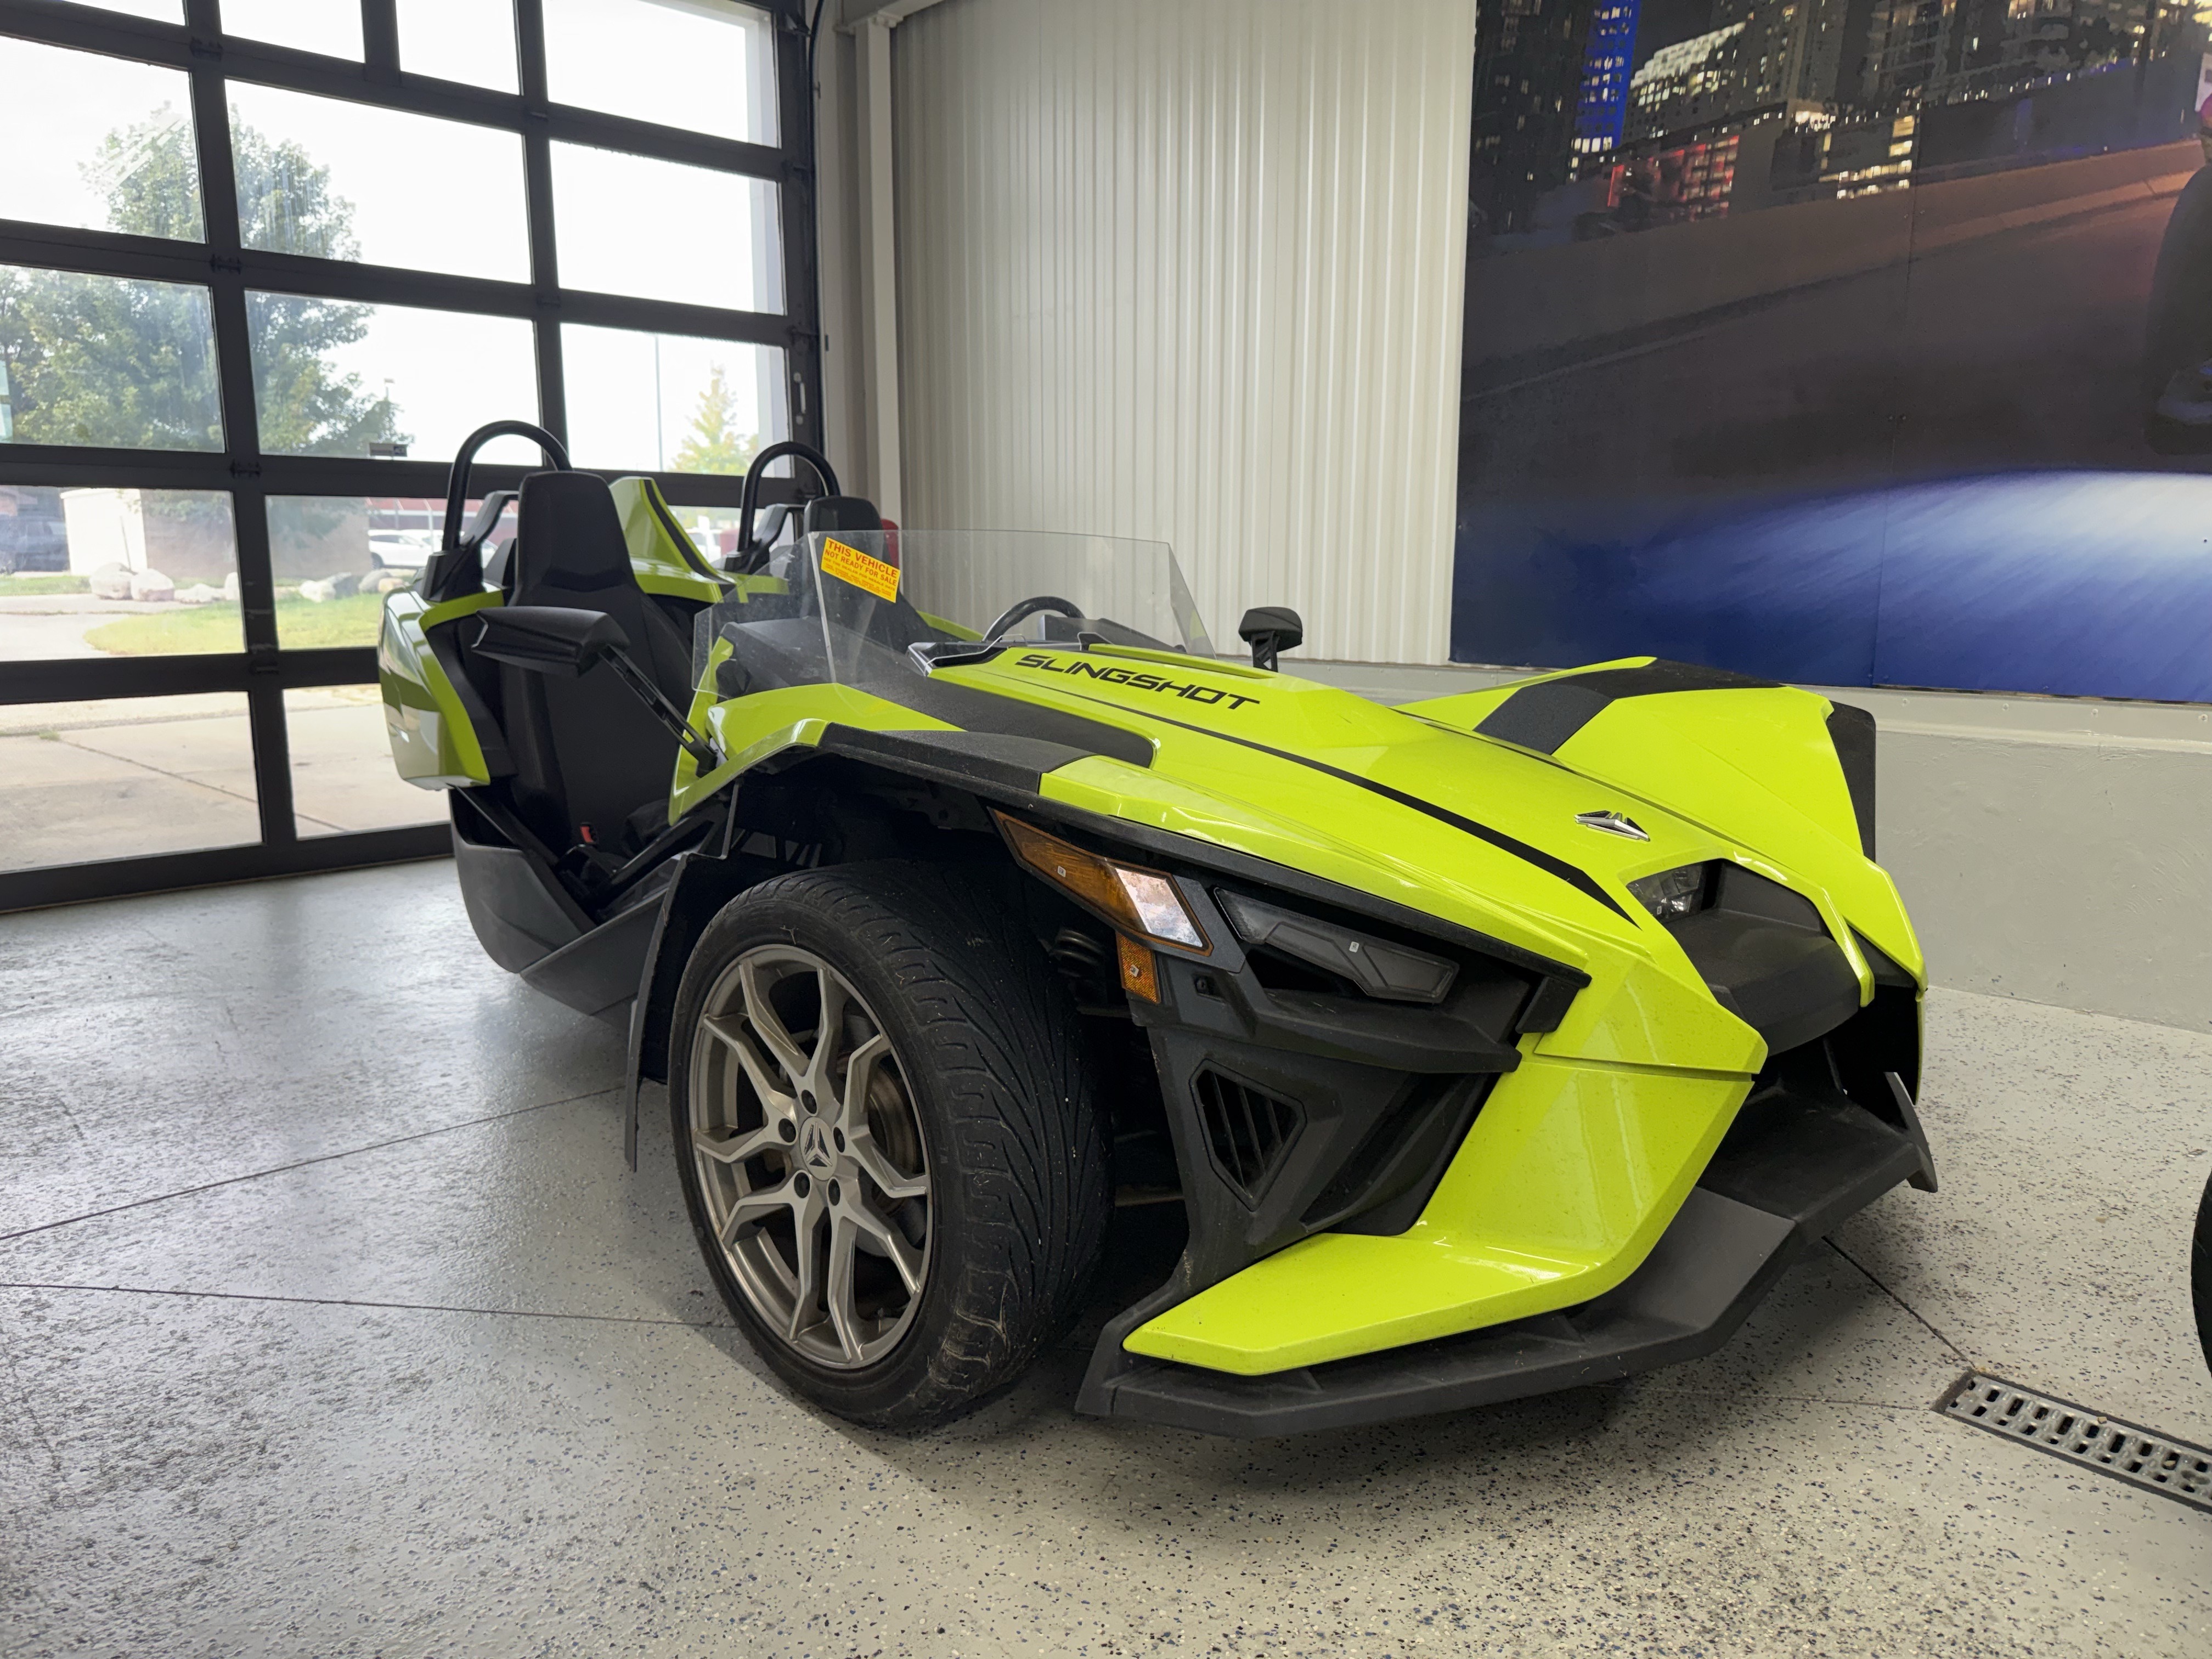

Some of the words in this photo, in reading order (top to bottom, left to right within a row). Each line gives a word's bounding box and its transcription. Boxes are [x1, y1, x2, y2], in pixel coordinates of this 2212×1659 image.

[825, 548, 839, 560] NOT
[840, 555, 863, 571] READY
[865, 567, 878, 578] FOR
[880, 573, 896, 586] SALE
[827, 539, 851, 557] THIS
[855, 552, 898, 578] VEHICLE
[1015, 654, 1260, 710] SLINGSHOT
